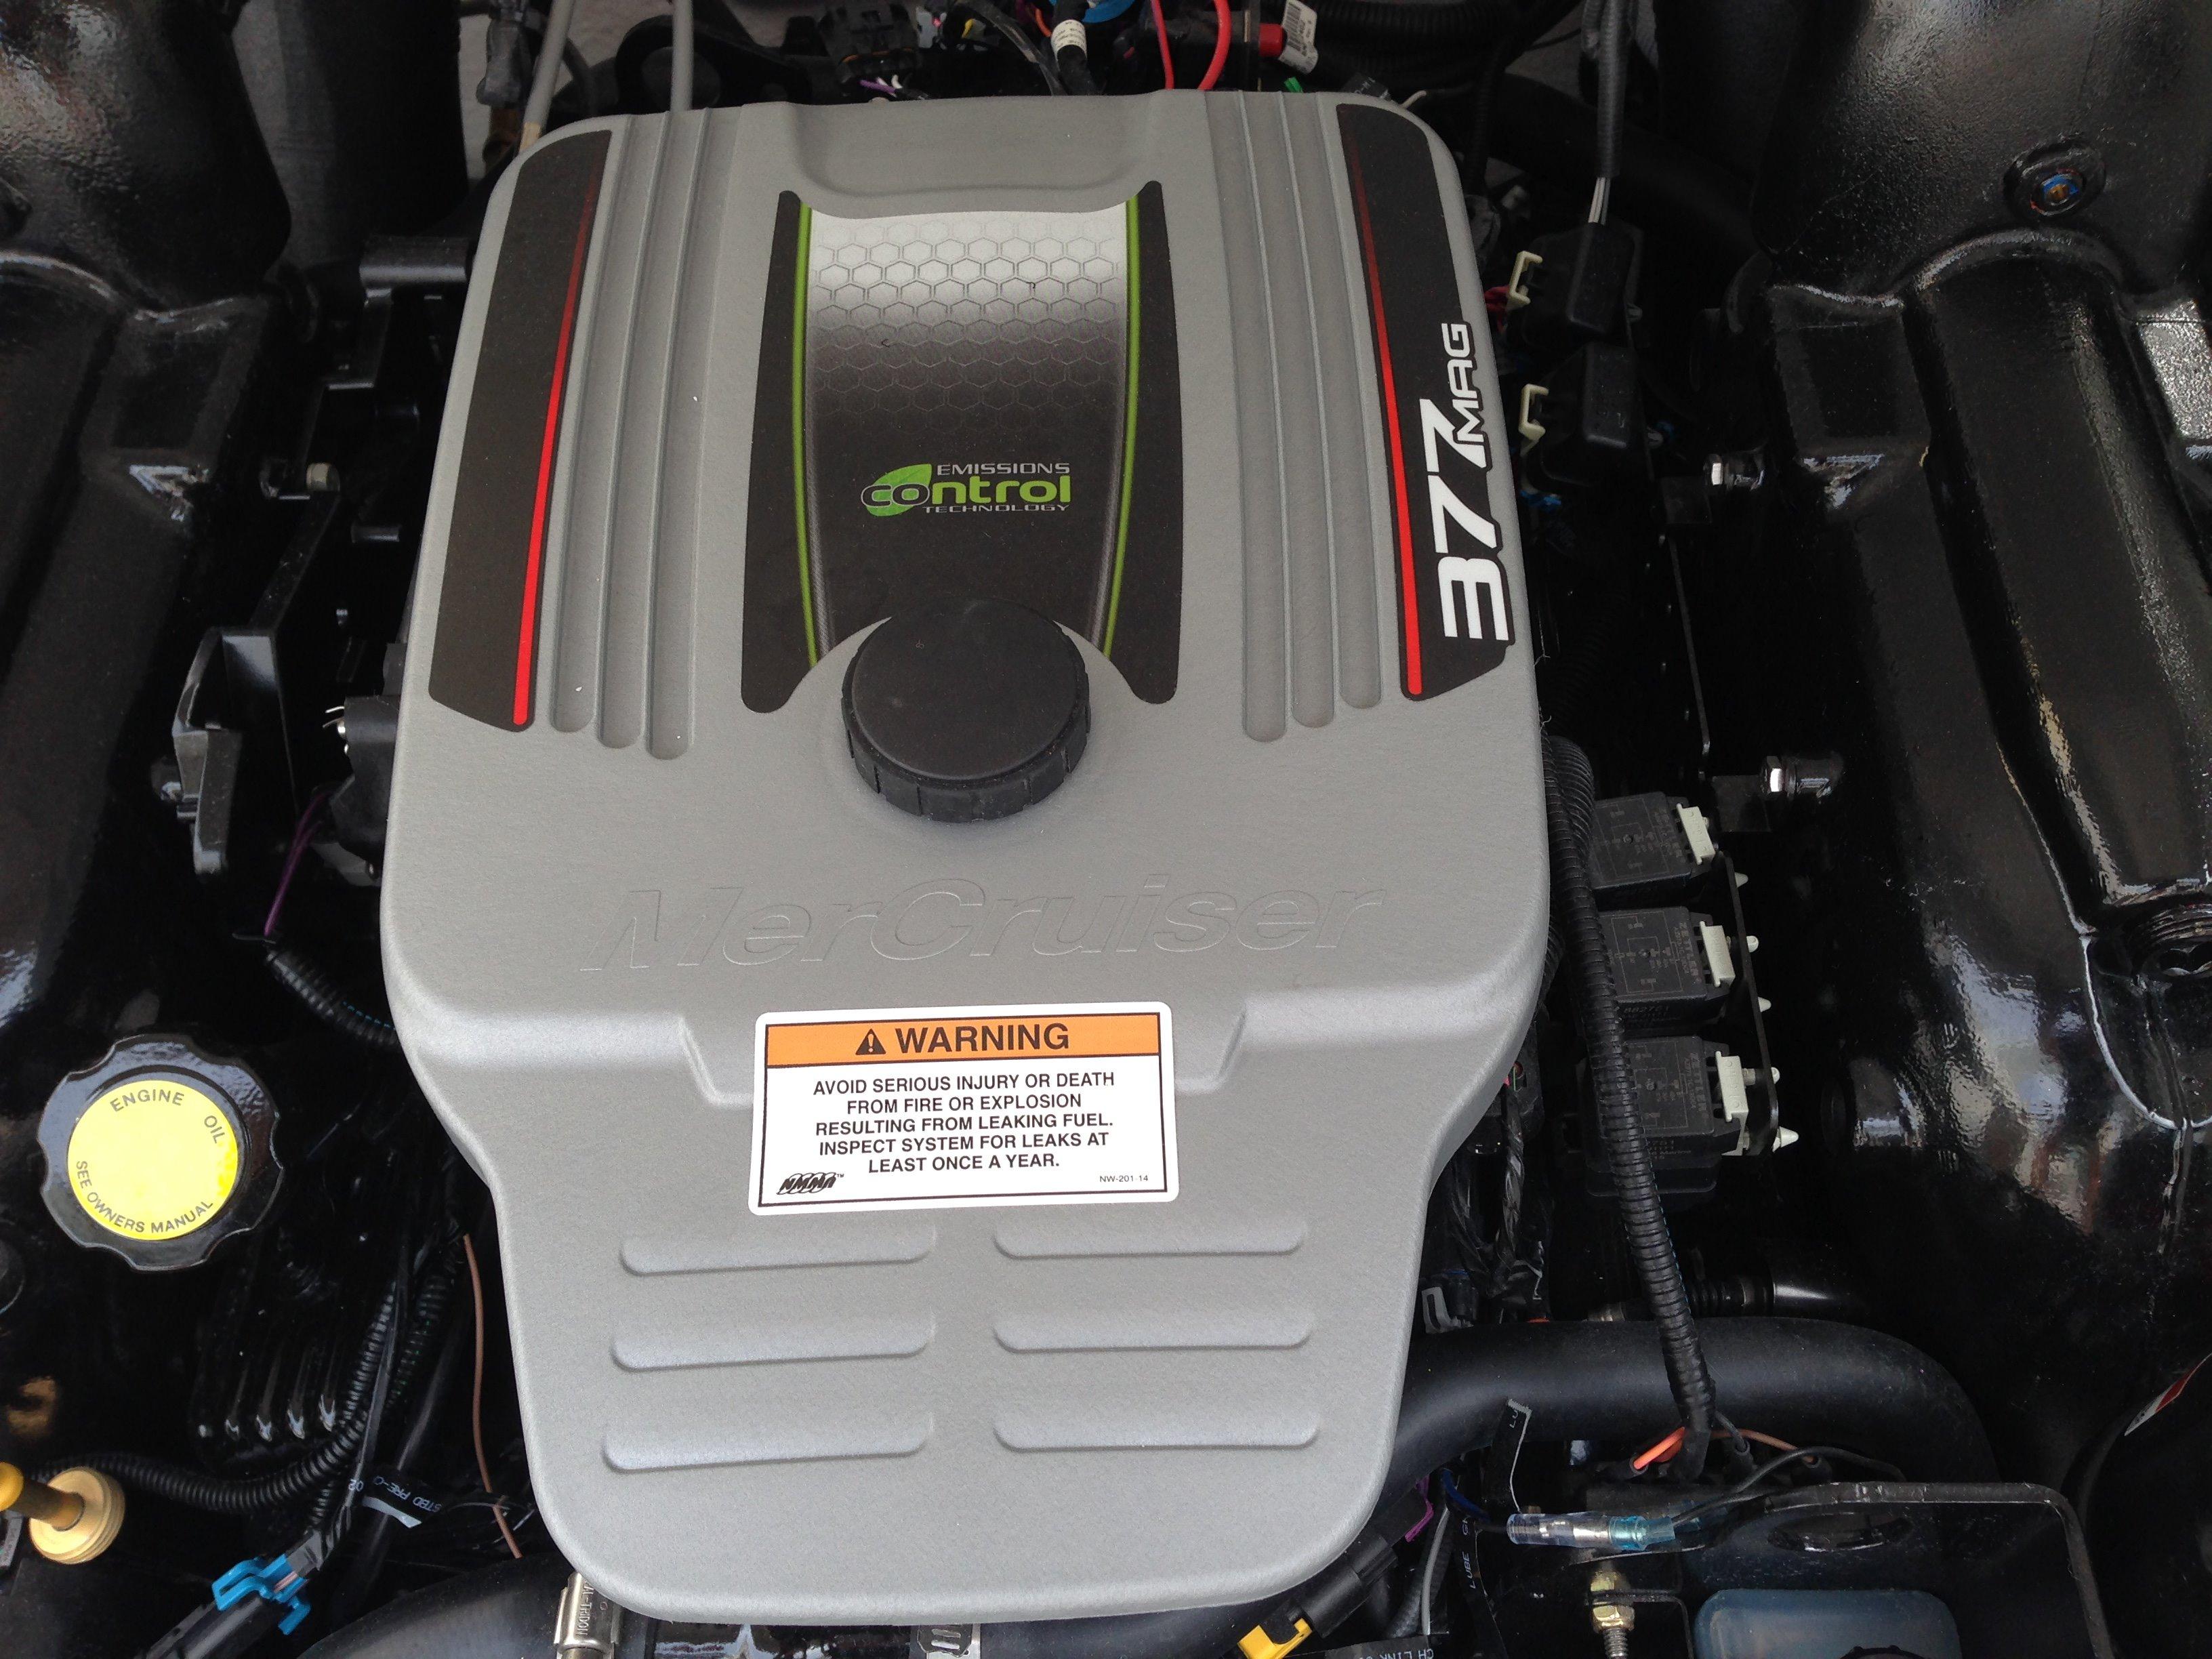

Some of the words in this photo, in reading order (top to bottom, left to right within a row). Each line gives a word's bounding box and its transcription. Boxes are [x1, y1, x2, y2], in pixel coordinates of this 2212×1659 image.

[1441, 323, 1484, 443] MAG
[937, 463, 1070, 476] EMISSIONS
[861, 475, 1071, 508] control
[922, 504, 1070, 514] TECHNOLOGY
[1420, 398, 1509, 641] 377
[580, 873, 1385, 972] MerCruiser
[895, 1023, 1068, 1053] WARNING
[814, 1080, 866, 1094] AVOID
[874, 1077, 950, 1092] SERIOUS
[958, 1075, 1019, 1089] INJURY
[1026, 1074, 1050, 1088] OR
[1057, 1073, 1113, 1086] DEATH
[110, 1089, 184, 1111] ENGINE
[204, 1115, 225, 1143] OIL
[848, 1099, 897, 1113] FROM
[905, 1098, 941, 1112] FIRE
[949, 1097, 973, 1111] OR
[981, 1094, 1080, 1109] EXPLOSION
[817, 1120, 914, 1135] RESULTING
[922, 1118, 971, 1130] FROM
[979, 1115, 1056, 1129] LEAKING
[1063, 1113, 1113, 1127] FUEL.
[820, 1139, 895, 1155] INSPECT
[902, 1136, 972, 1151] SYSTEM
[981, 1135, 1015, 1148] FOR
[1023, 1133, 1081, 1147] LEAKS
[1088, 1132, 1108, 1145] AT
[869, 1158, 926, 1172] LEAST
[933, 1156, 982, 1170] ONCE
[989, 1155, 1000, 1168] A
[1006, 1153, 1059, 1168] YEAR.
[76, 1160, 92, 1189] SEE
[87, 1191, 146, 1233] OWNERS
[151, 1201, 213, 1233] MANUAL
[412, 1496, 443, 1513] STBD
[1462, 1551, 1476, 1589] LUBE
